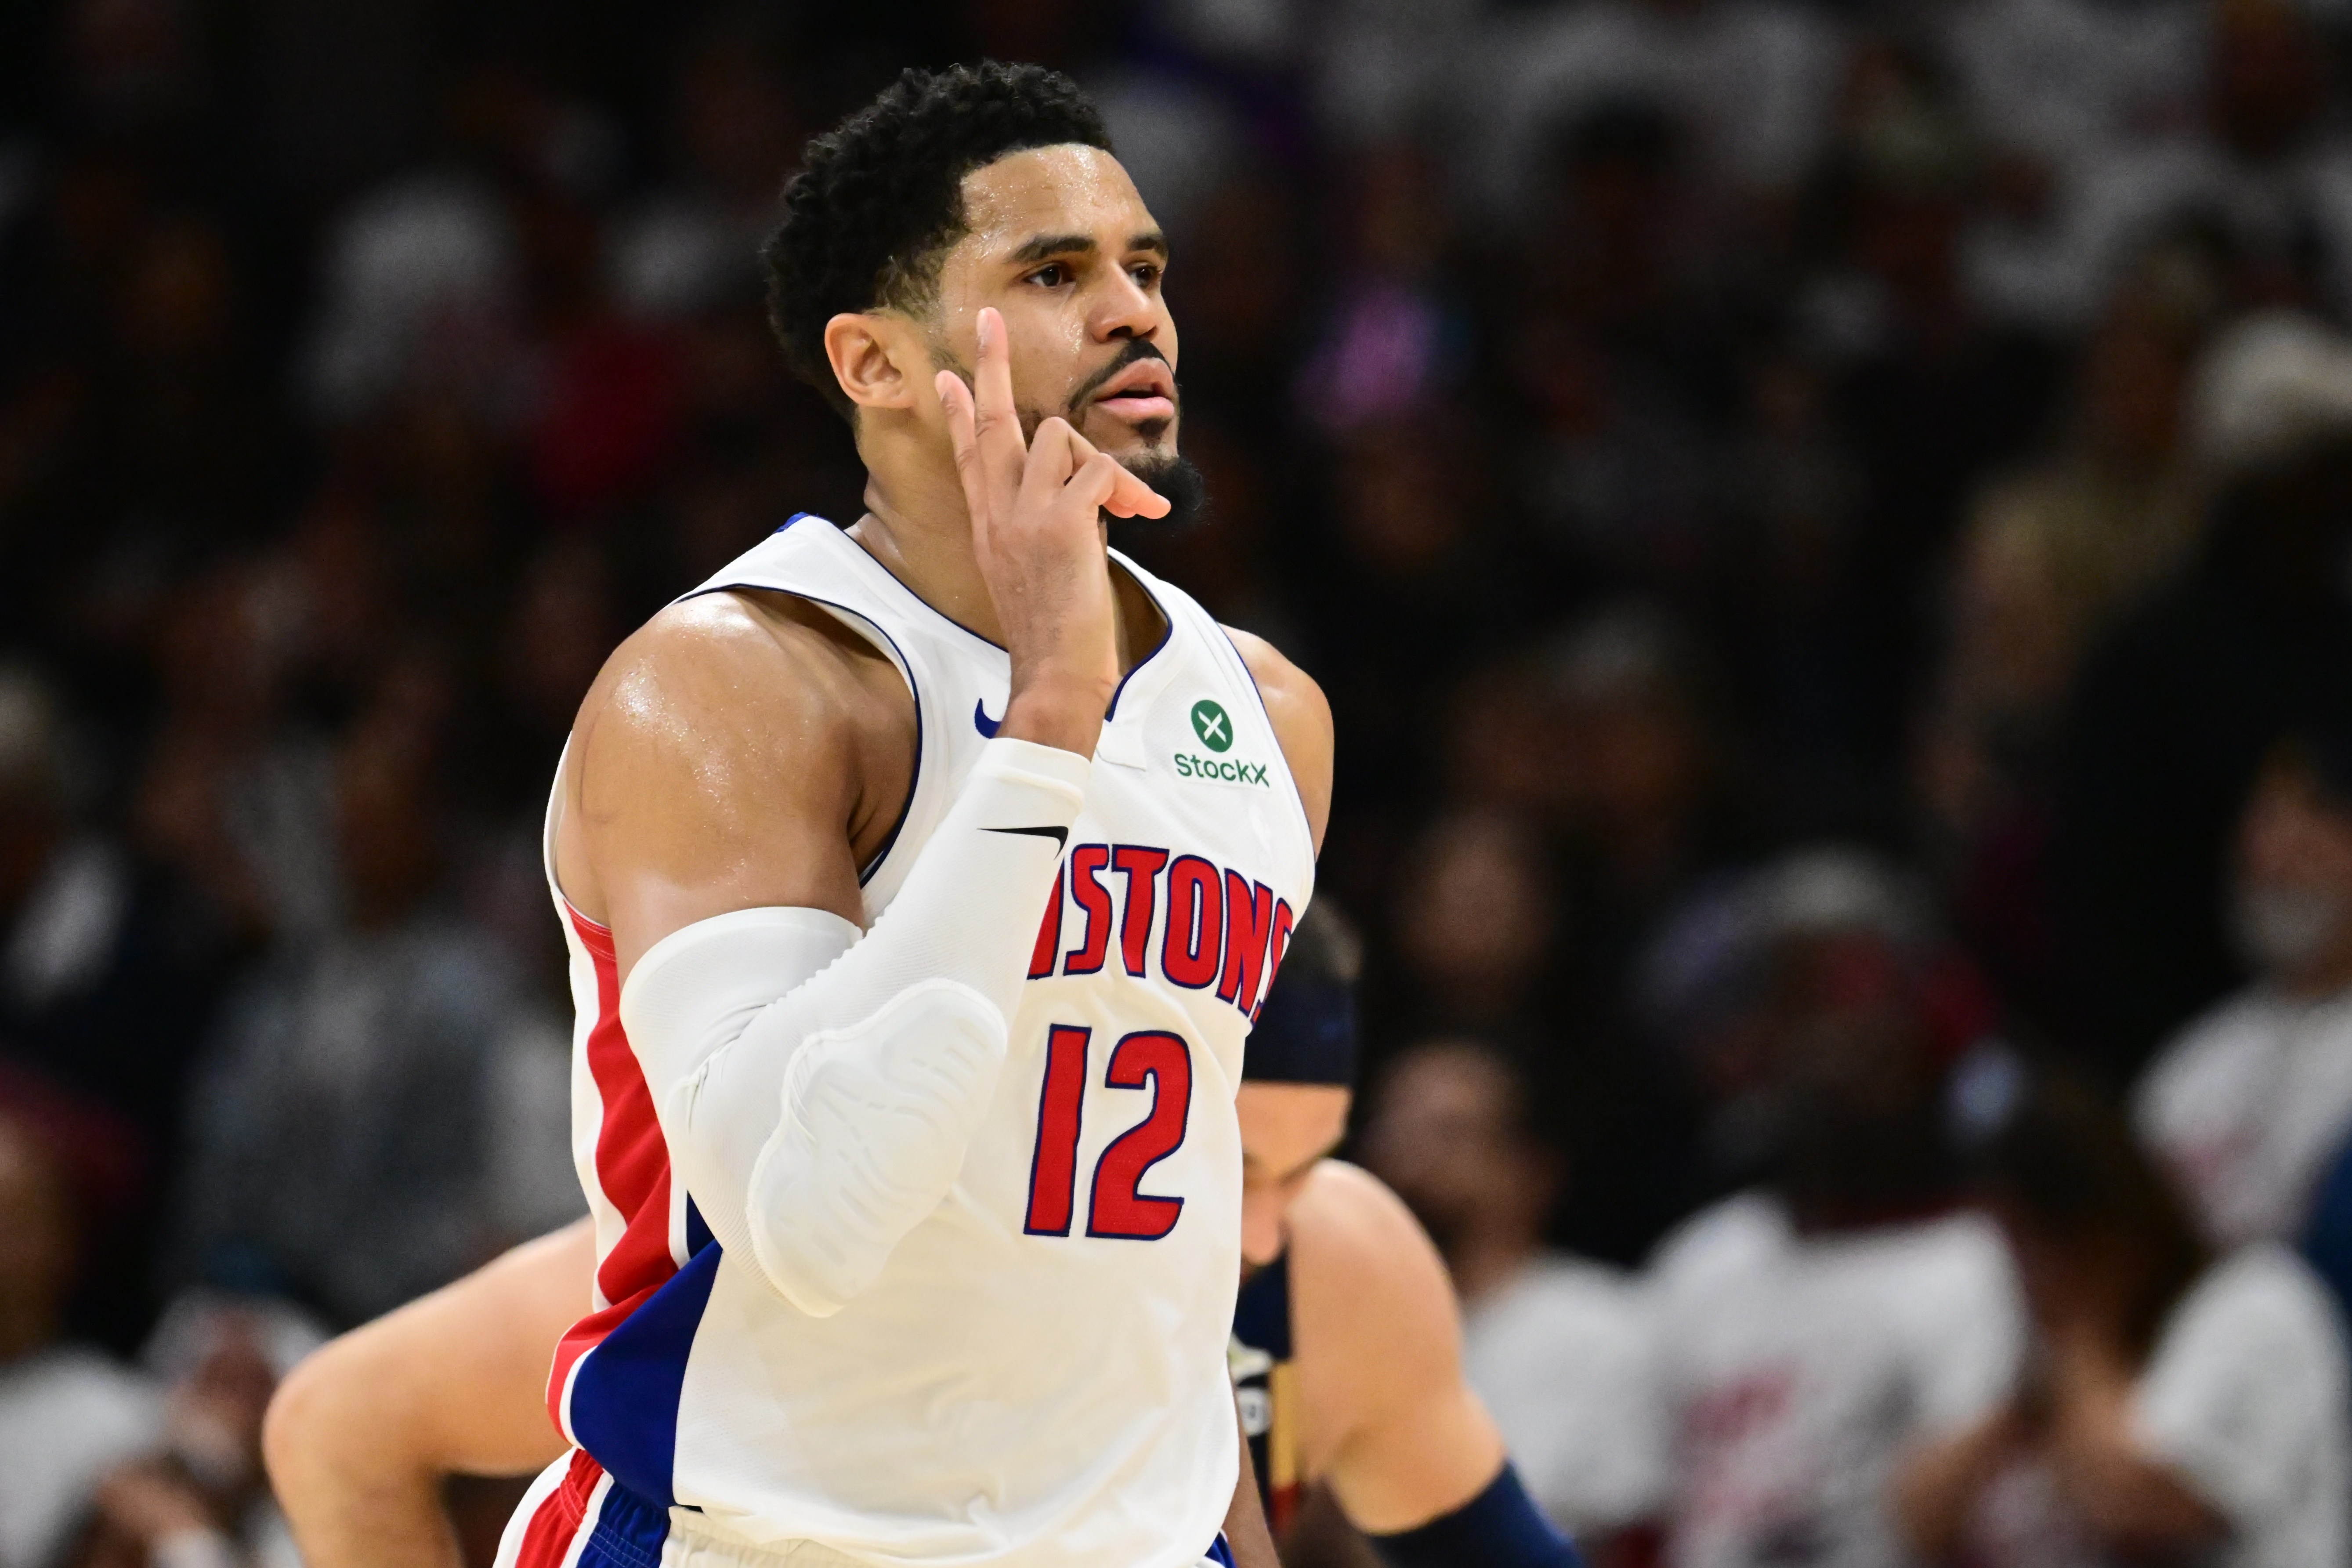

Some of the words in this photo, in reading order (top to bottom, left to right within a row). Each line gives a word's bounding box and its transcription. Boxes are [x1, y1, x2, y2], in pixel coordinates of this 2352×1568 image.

[1174, 753, 1270, 789] StockX
[1027, 843, 1293, 1028] ISTONS
[1023, 1023, 1192, 1241] 12
